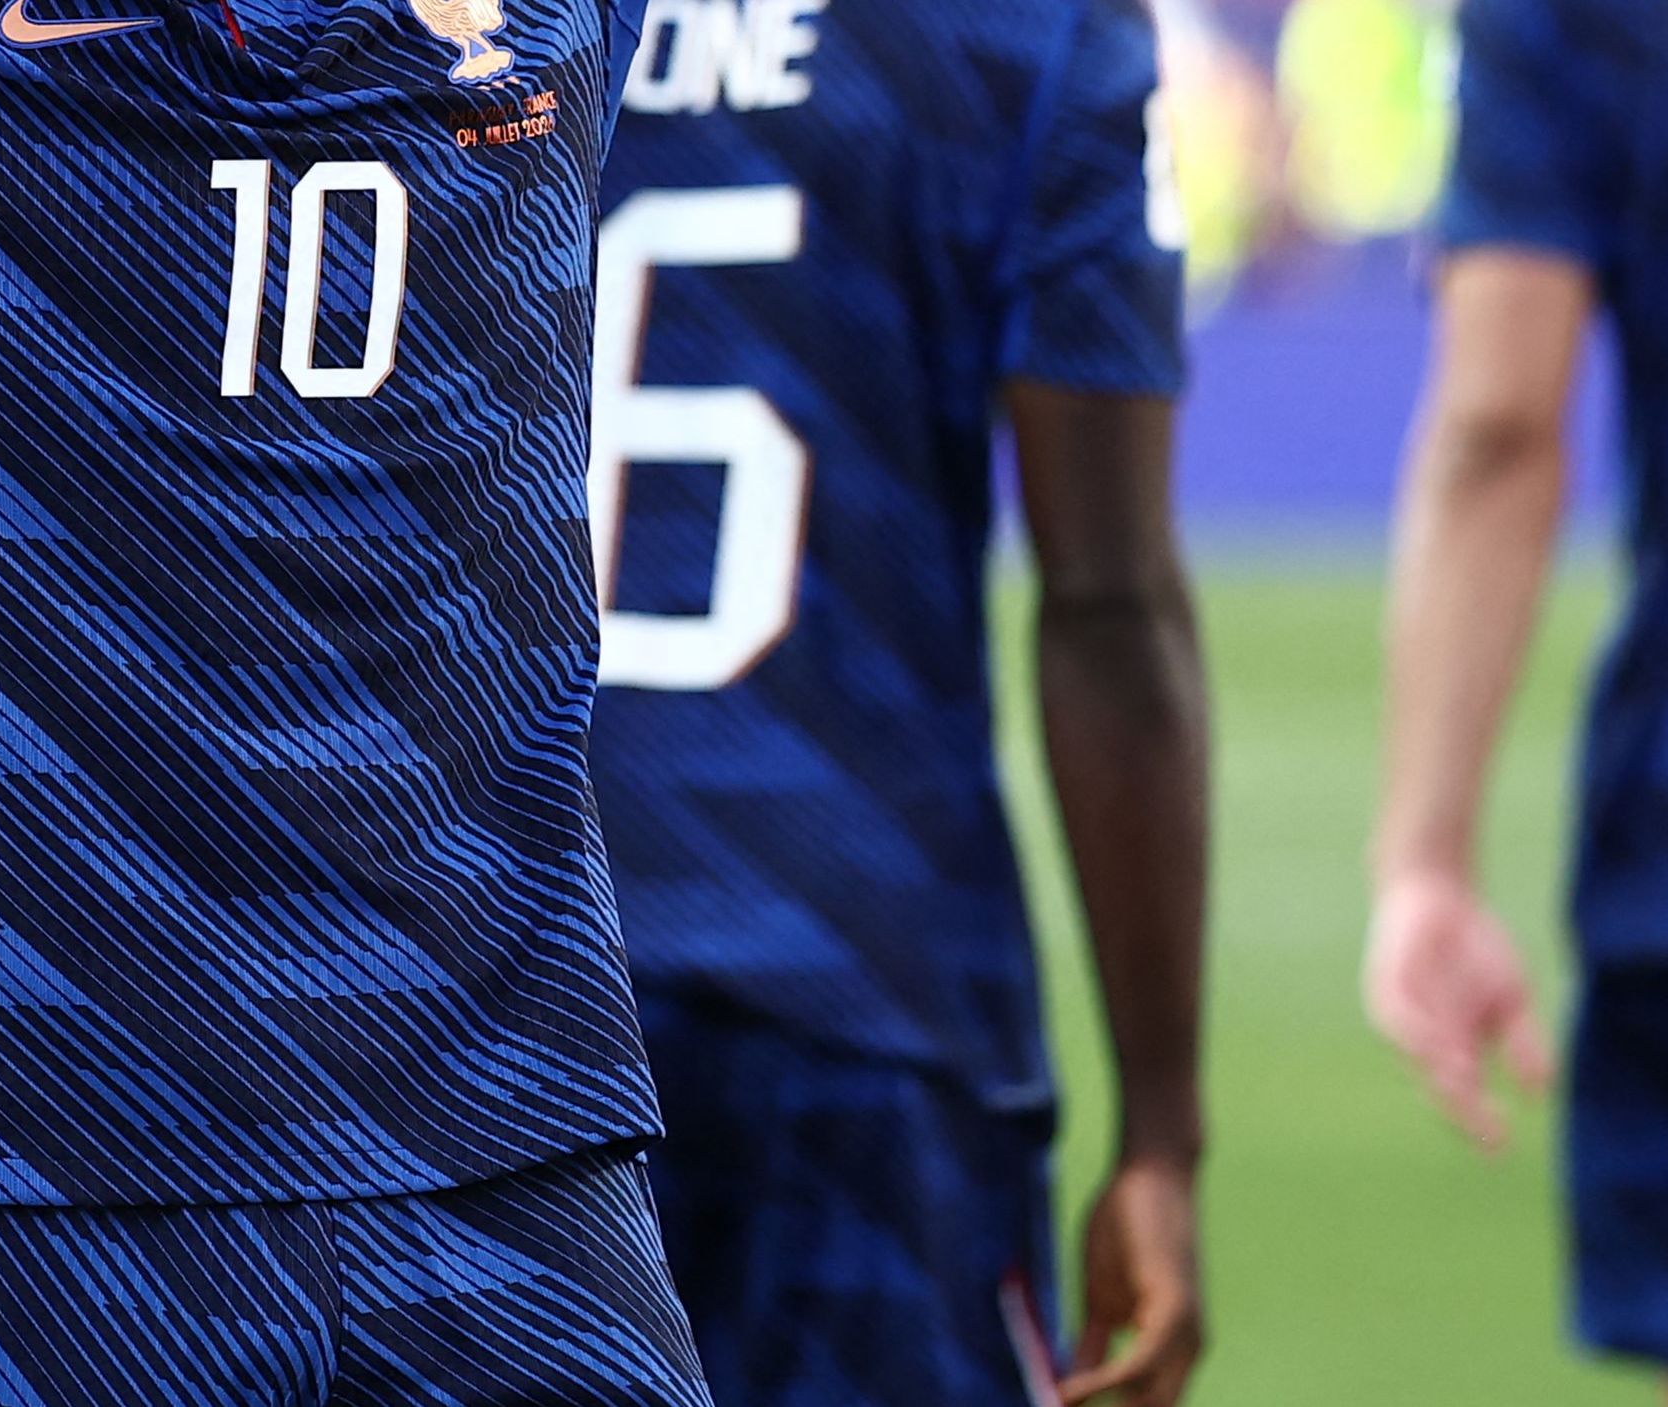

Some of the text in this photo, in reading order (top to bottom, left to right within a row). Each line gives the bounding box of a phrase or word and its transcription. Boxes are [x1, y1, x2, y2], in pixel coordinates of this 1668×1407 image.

[456, 128, 478, 148] 04
[210, 158, 409, 398] 10
[588, 184, 814, 693] 6
